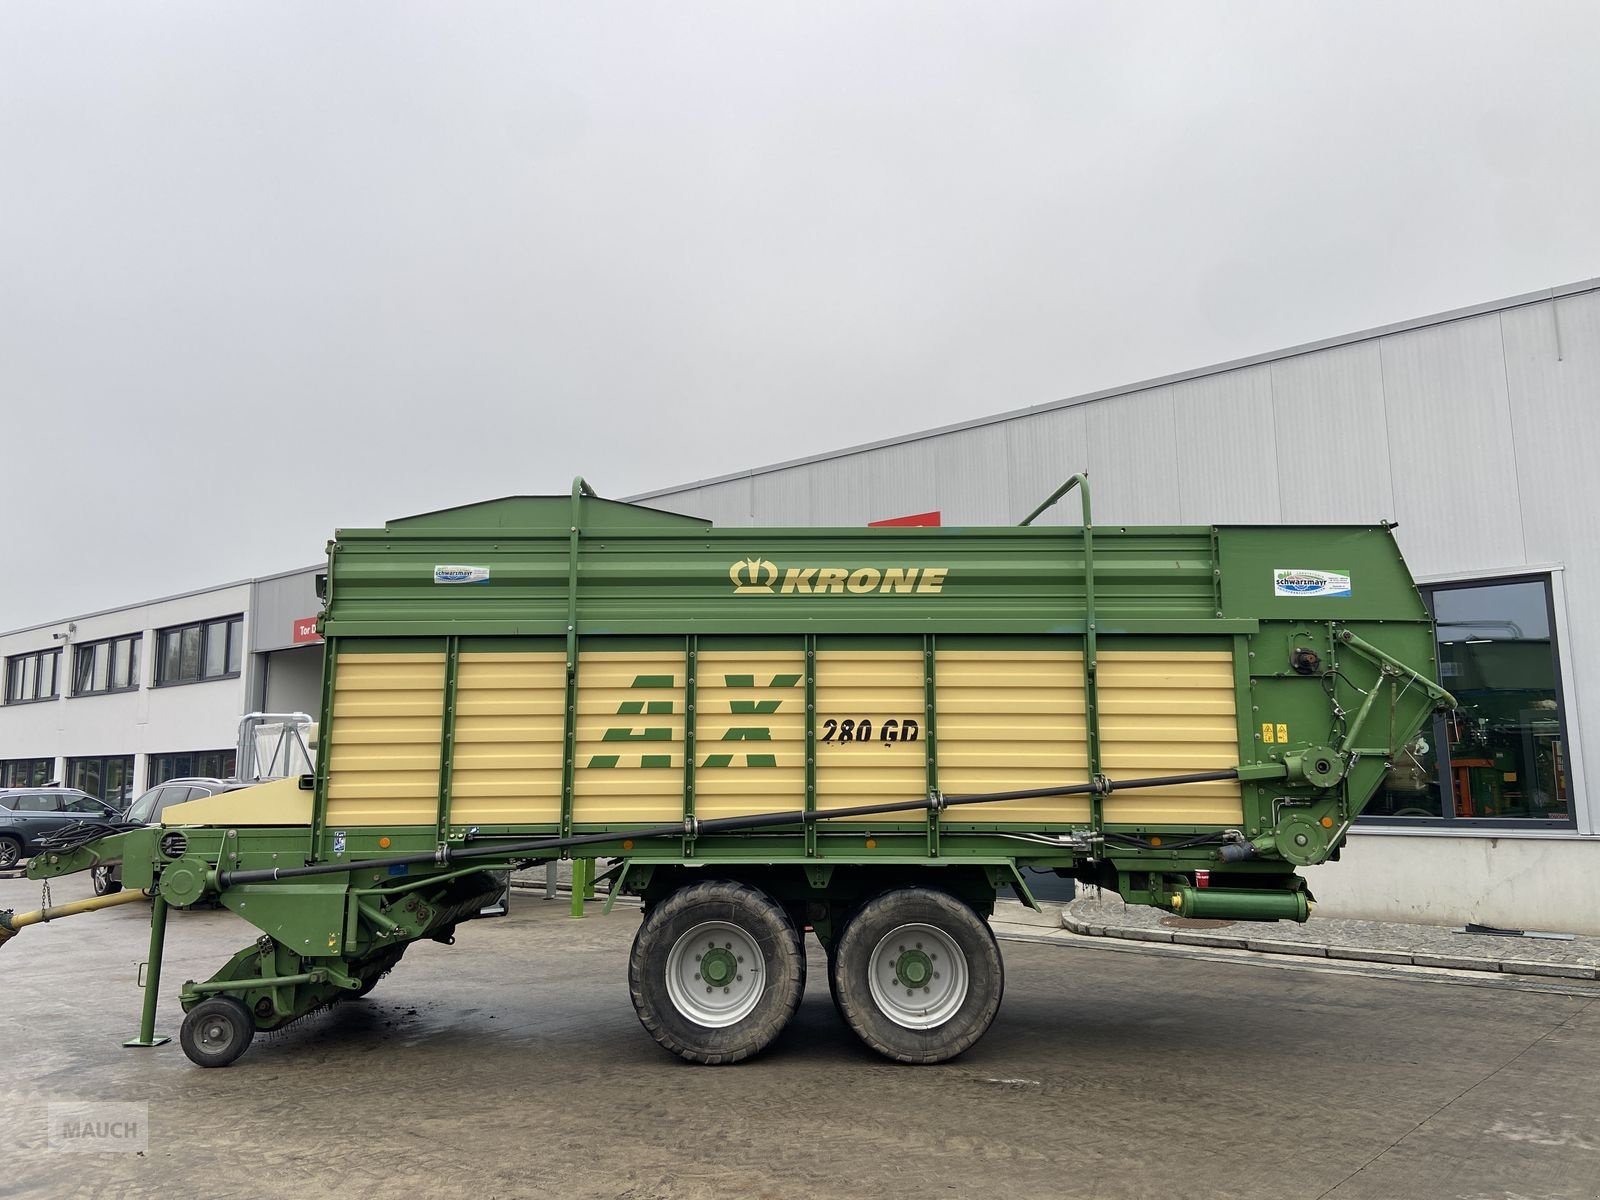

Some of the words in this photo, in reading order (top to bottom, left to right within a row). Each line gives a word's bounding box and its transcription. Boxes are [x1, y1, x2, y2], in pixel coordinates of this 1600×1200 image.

[780, 567, 949, 594] KRONE
[1276, 578, 1327, 586] schwarzmayr
[300, 626, 310, 636] Tor
[820, 719, 872, 743] 280
[880, 719, 919, 744] GD
